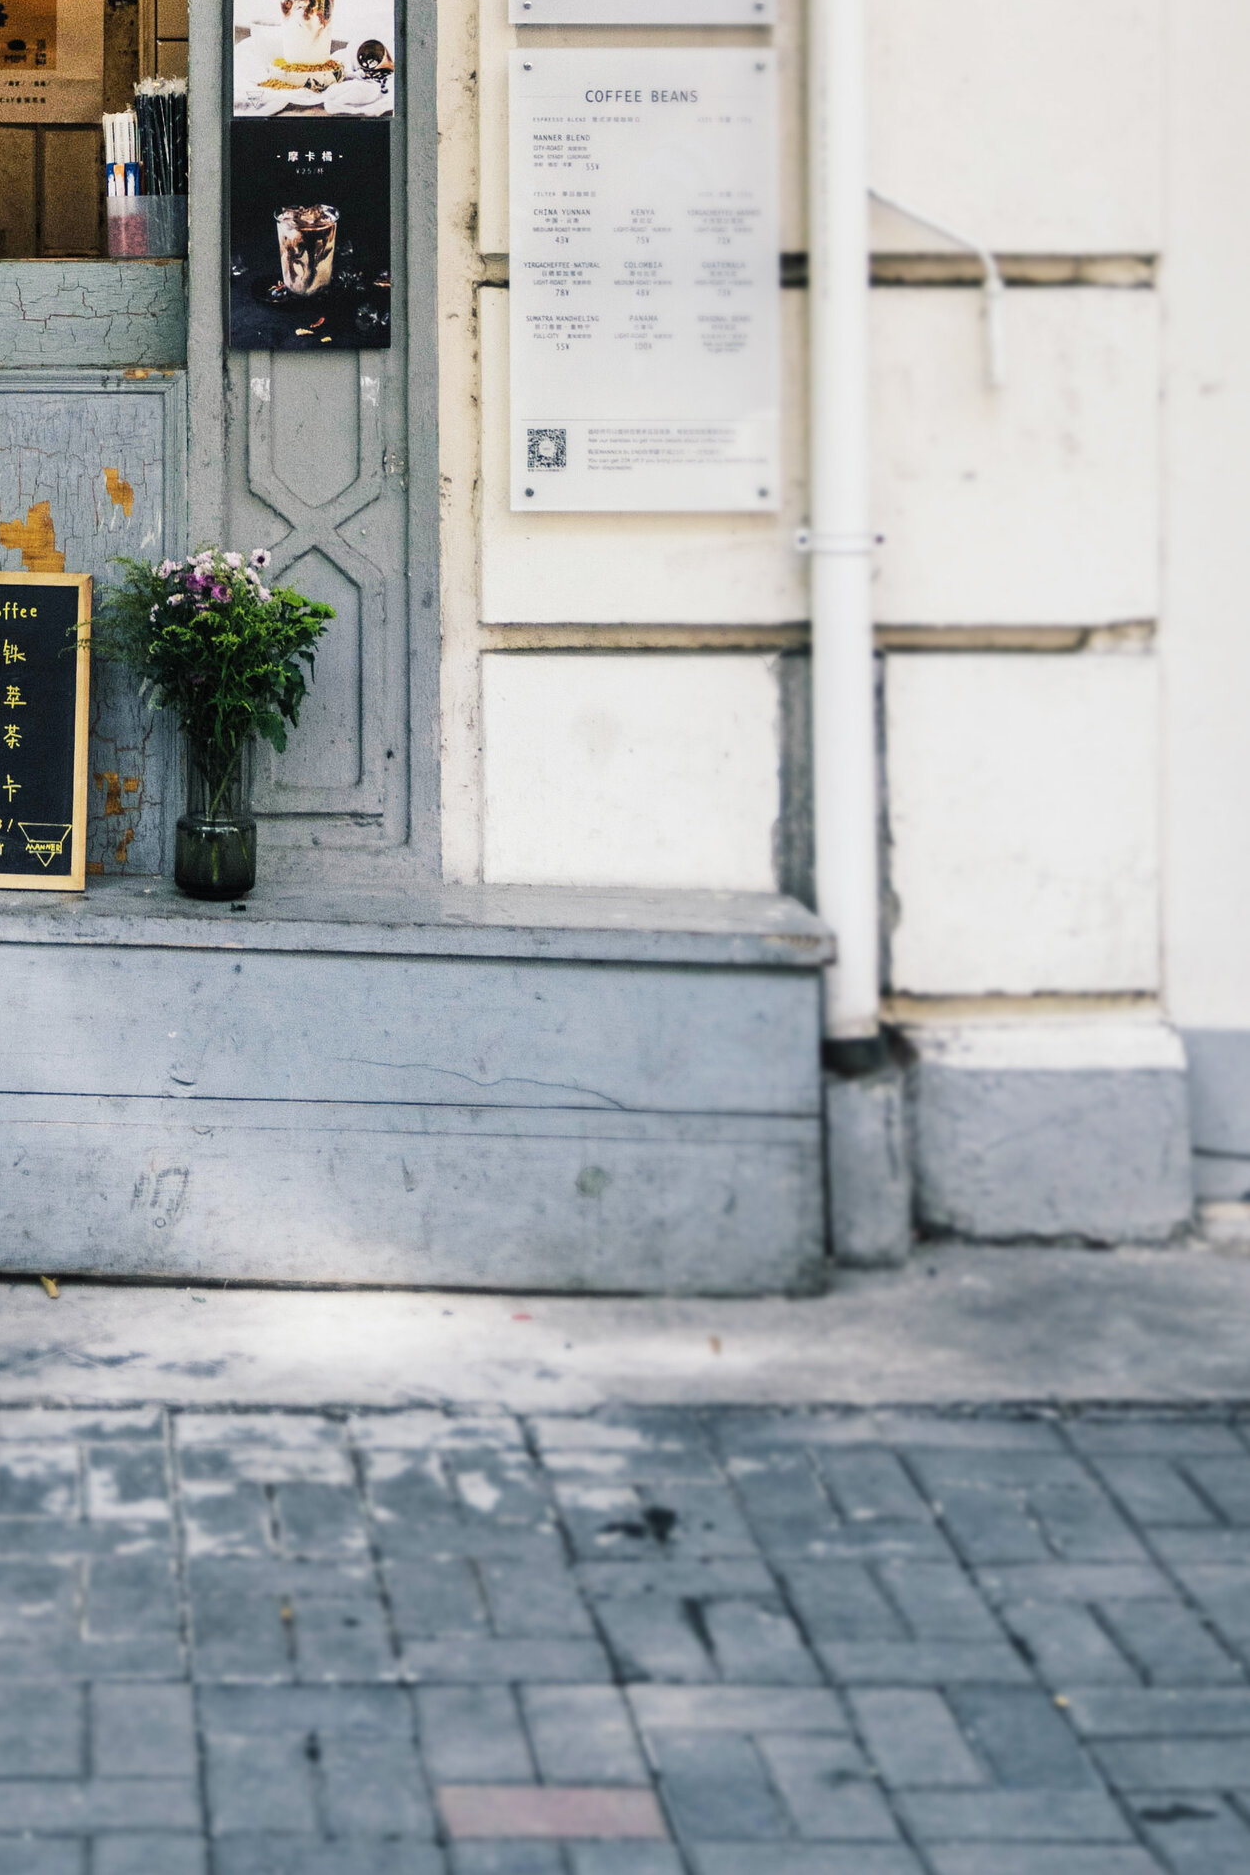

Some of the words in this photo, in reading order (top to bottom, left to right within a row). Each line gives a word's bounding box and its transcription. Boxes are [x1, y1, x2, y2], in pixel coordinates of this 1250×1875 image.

[585, 90, 643, 103] COFFEE
[651, 90, 699, 103] BEANS
[25, 843, 61, 853] MANNER
